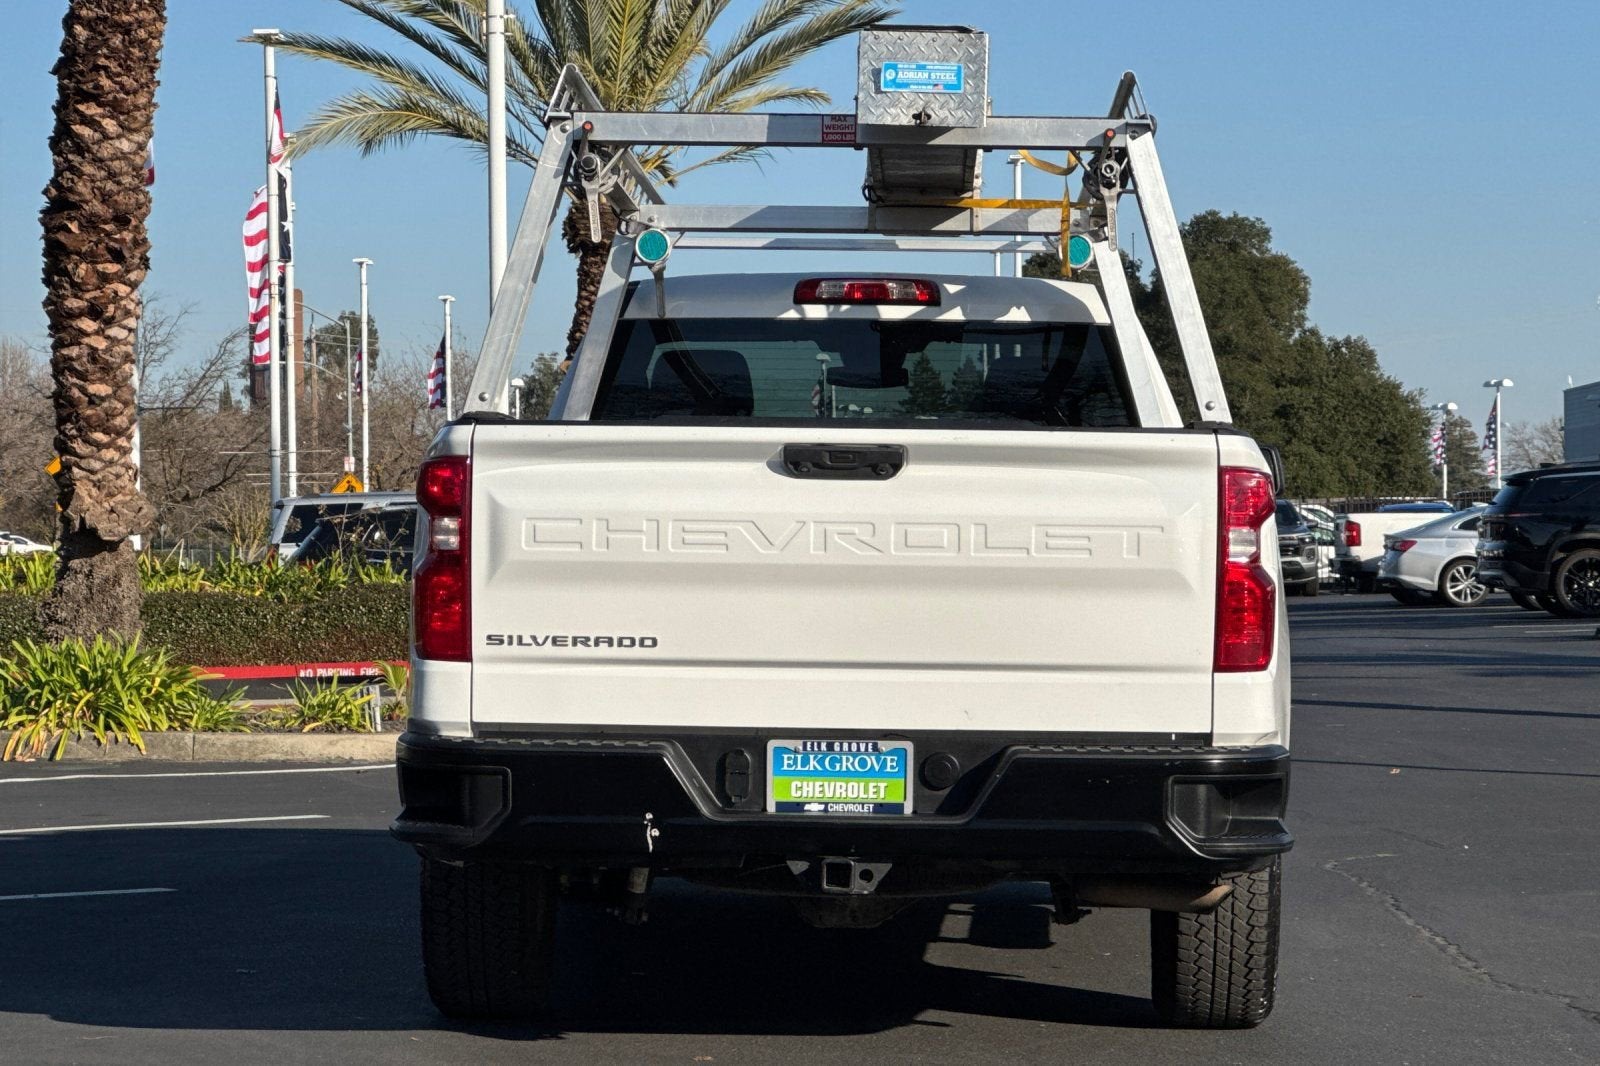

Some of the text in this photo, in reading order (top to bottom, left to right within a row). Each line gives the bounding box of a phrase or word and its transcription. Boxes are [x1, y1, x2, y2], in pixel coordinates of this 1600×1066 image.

[897, 71, 957, 81] ADRIAN STEEL
[842, 133, 855, 141] LBS
[522, 517, 1164, 558] CHEVROLET
[486, 634, 658, 648] SILVERADO
[300, 668, 313, 678] NO
[807, 742, 873, 752] ELK GROVE
[781, 754, 899, 772] ELK GROVE
[791, 780, 887, 799] CHEVROLET
[828, 803, 874, 813] CHEVROLET
